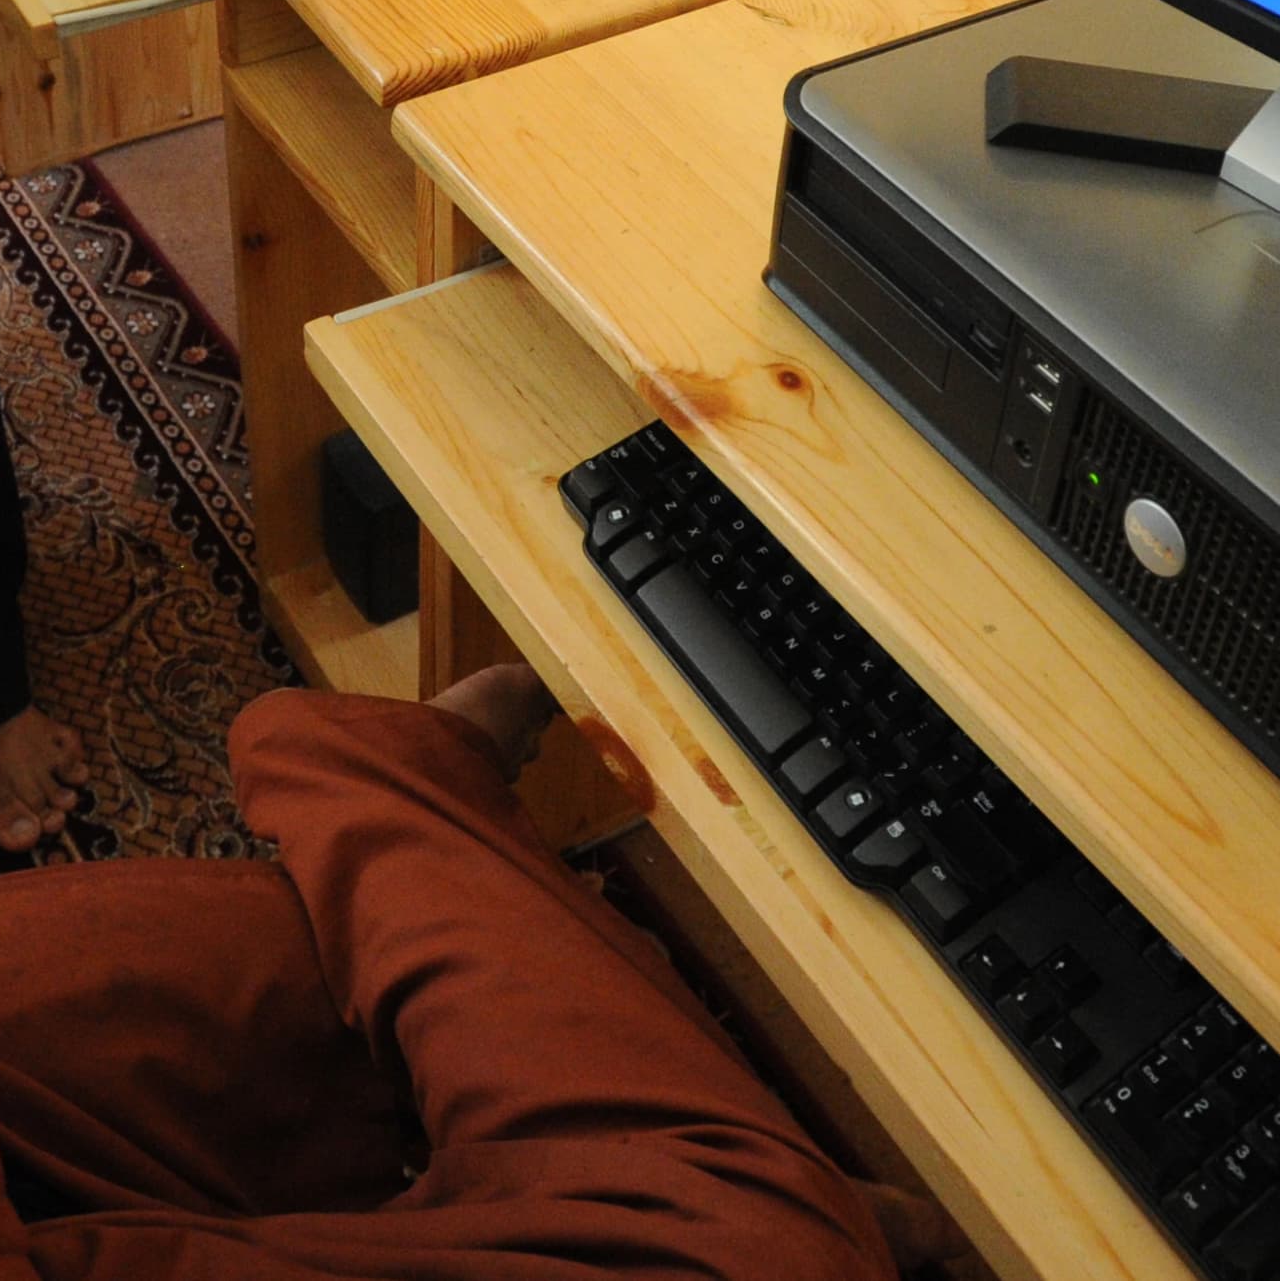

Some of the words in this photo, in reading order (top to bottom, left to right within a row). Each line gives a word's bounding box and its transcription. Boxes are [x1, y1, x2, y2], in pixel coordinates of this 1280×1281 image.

[687, 470, 698, 480] A
[709, 494, 721, 505] S
[664, 501, 678, 511] Z
[732, 519, 744, 531] D
[688, 526, 701, 538] X
[711, 553, 724, 564] C
[782, 574, 794, 586] G
[736, 581, 748, 592] V
[807, 601, 820, 614] H
[760, 609, 772, 620] B
[833, 632, 846, 641] J
[785, 637, 799, 650] N
[861, 660, 875, 673] K
[811, 667, 826, 681] M
[888, 691, 899, 702] L
[1195, 1025, 1207, 1036] 4
[1156, 1054, 1168, 1066] 1
[1232, 1065, 1247, 1079] 5
[1117, 1087, 1132, 1101] 0
[1194, 1098, 1209, 1113] 2
[1236, 1144, 1250, 1159] 3
[1183, 1191, 1199, 1209] Del
